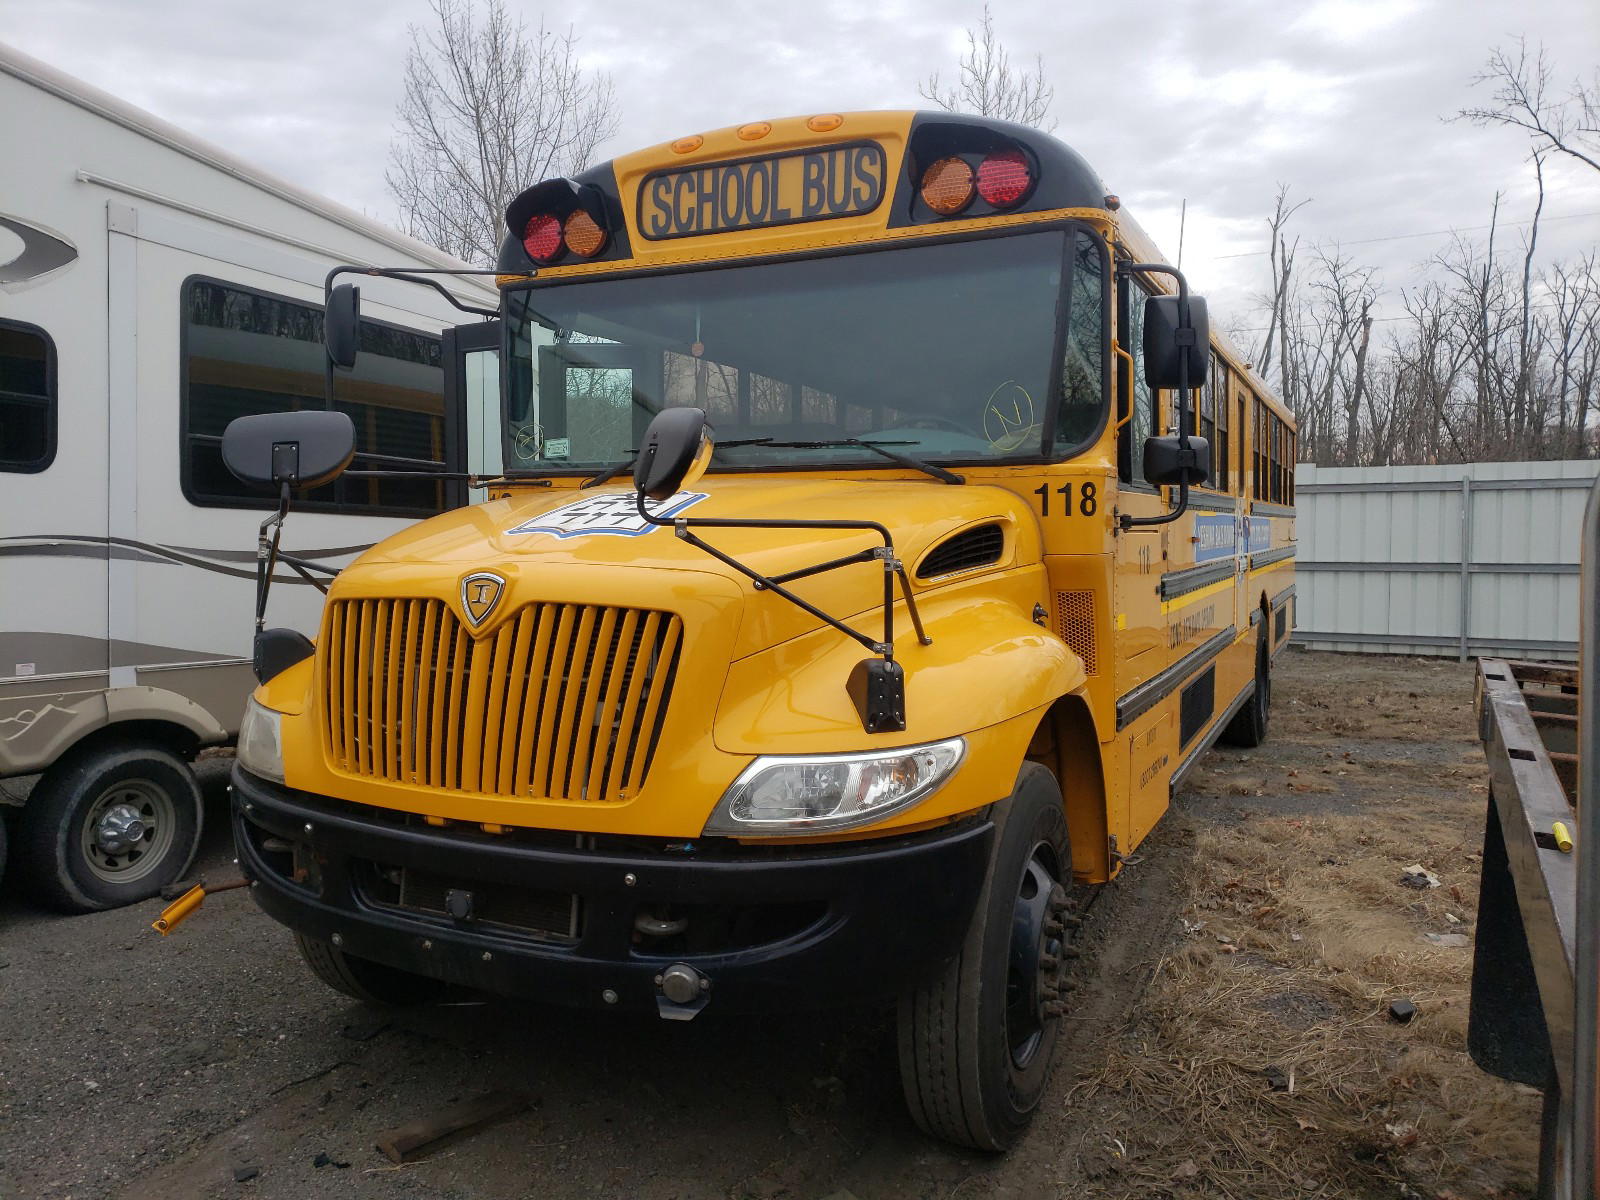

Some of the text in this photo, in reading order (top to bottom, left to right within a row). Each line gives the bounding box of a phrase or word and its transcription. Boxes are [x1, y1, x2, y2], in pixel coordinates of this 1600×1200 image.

[651, 147, 879, 235] SCHOOL BUS
[1034, 481, 1097, 517] 118
